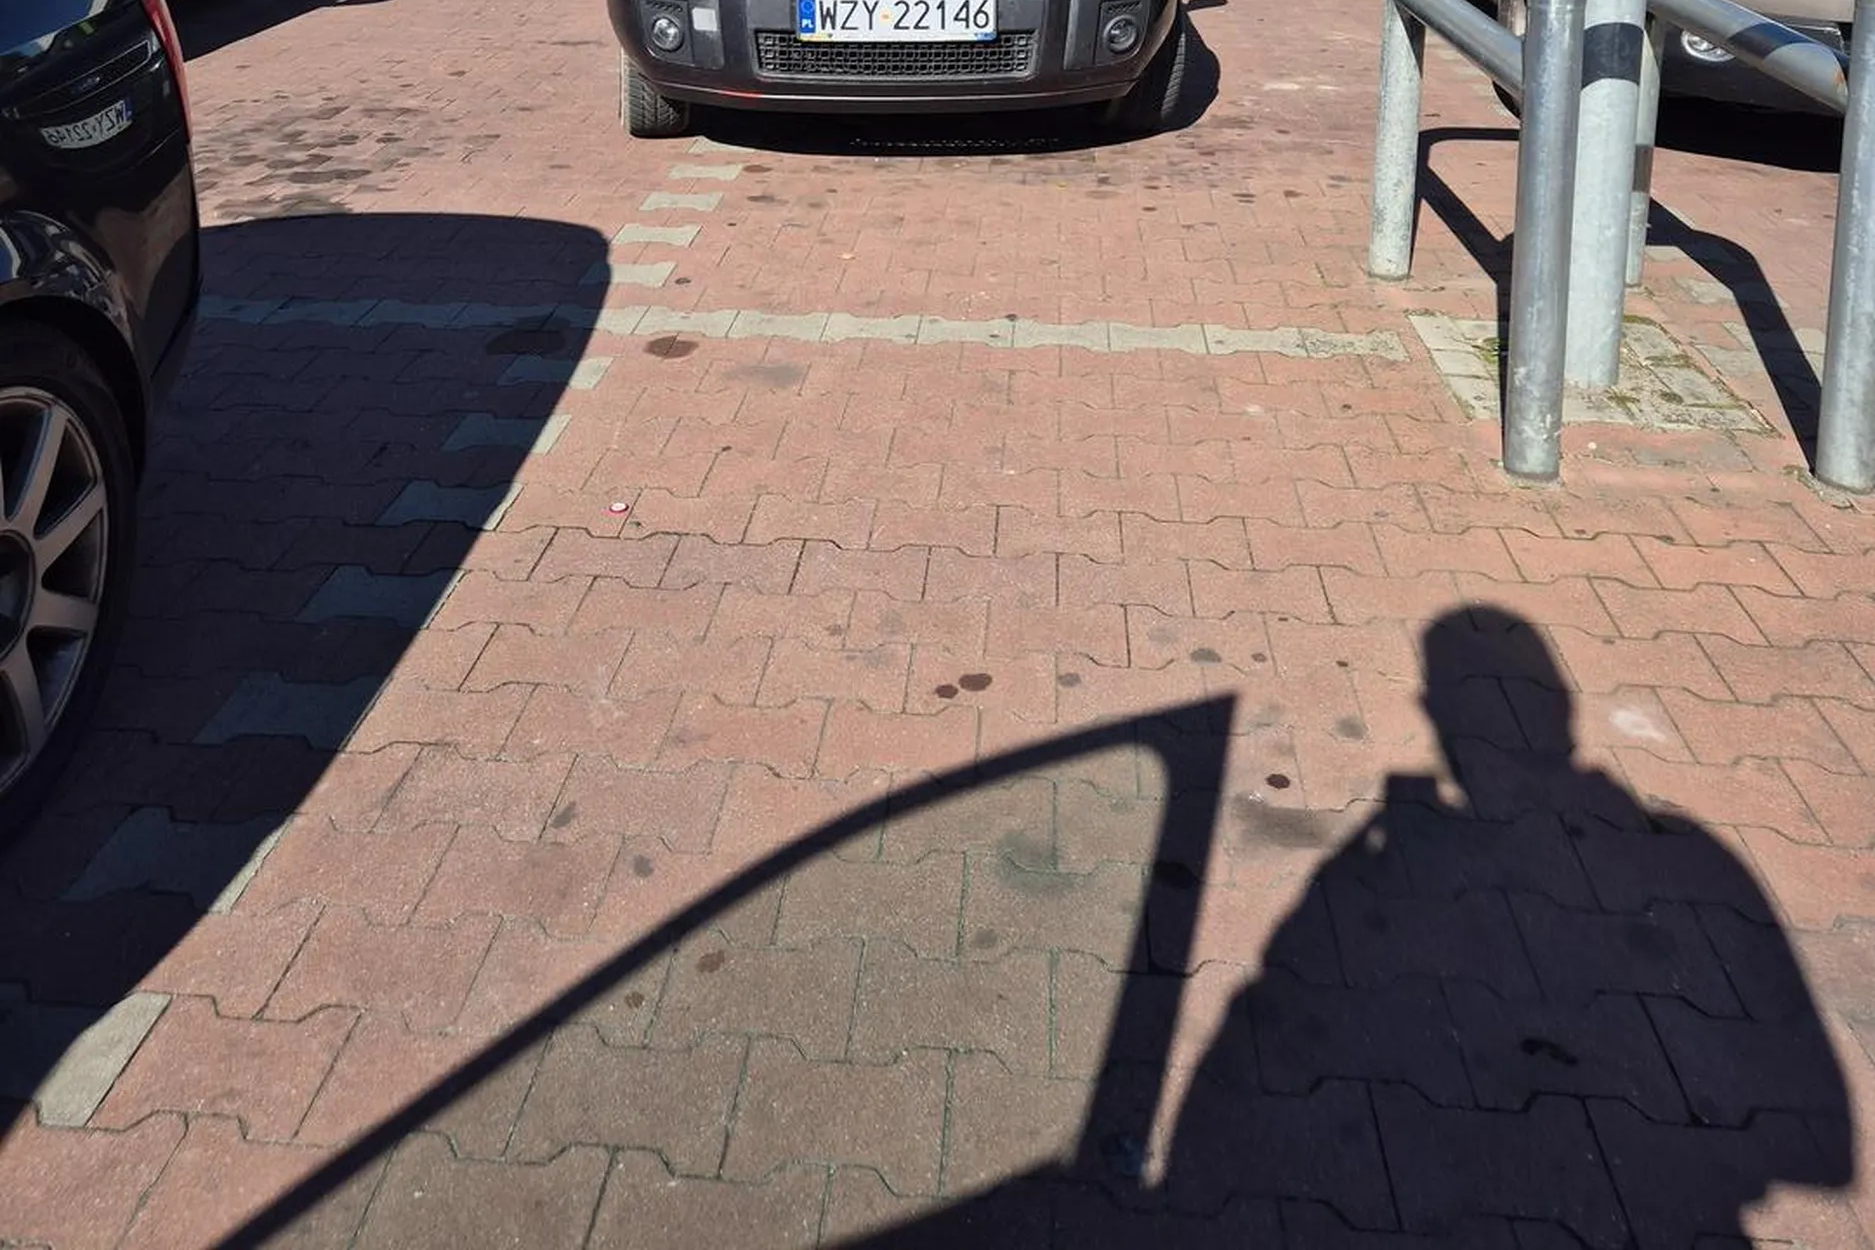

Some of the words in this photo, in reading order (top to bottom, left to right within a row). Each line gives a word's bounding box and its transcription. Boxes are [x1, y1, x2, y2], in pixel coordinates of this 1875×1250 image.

[801, 18, 814, 29] PL
[819, 0, 880, 31] WZY
[893, 0, 990, 30] 22146
